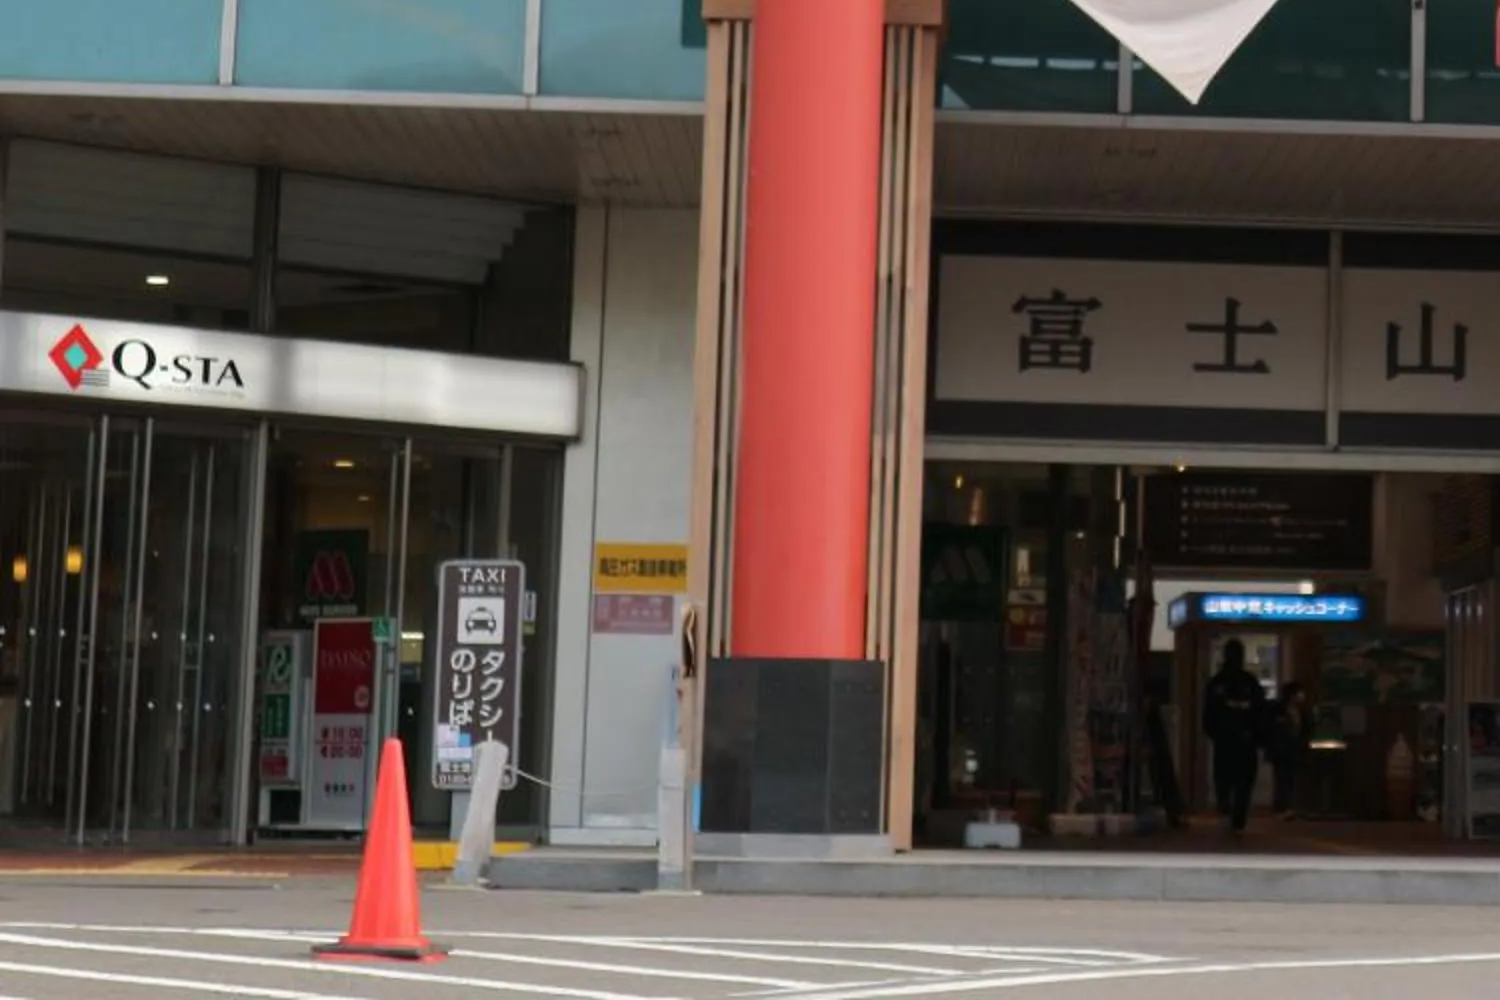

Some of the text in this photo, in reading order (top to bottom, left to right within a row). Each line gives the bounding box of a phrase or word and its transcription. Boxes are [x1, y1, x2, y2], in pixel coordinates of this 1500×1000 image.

[112, 339, 244, 390] Q-STA
[459, 567, 506, 583] TAXI
[449, 648, 476, 730] のりば
